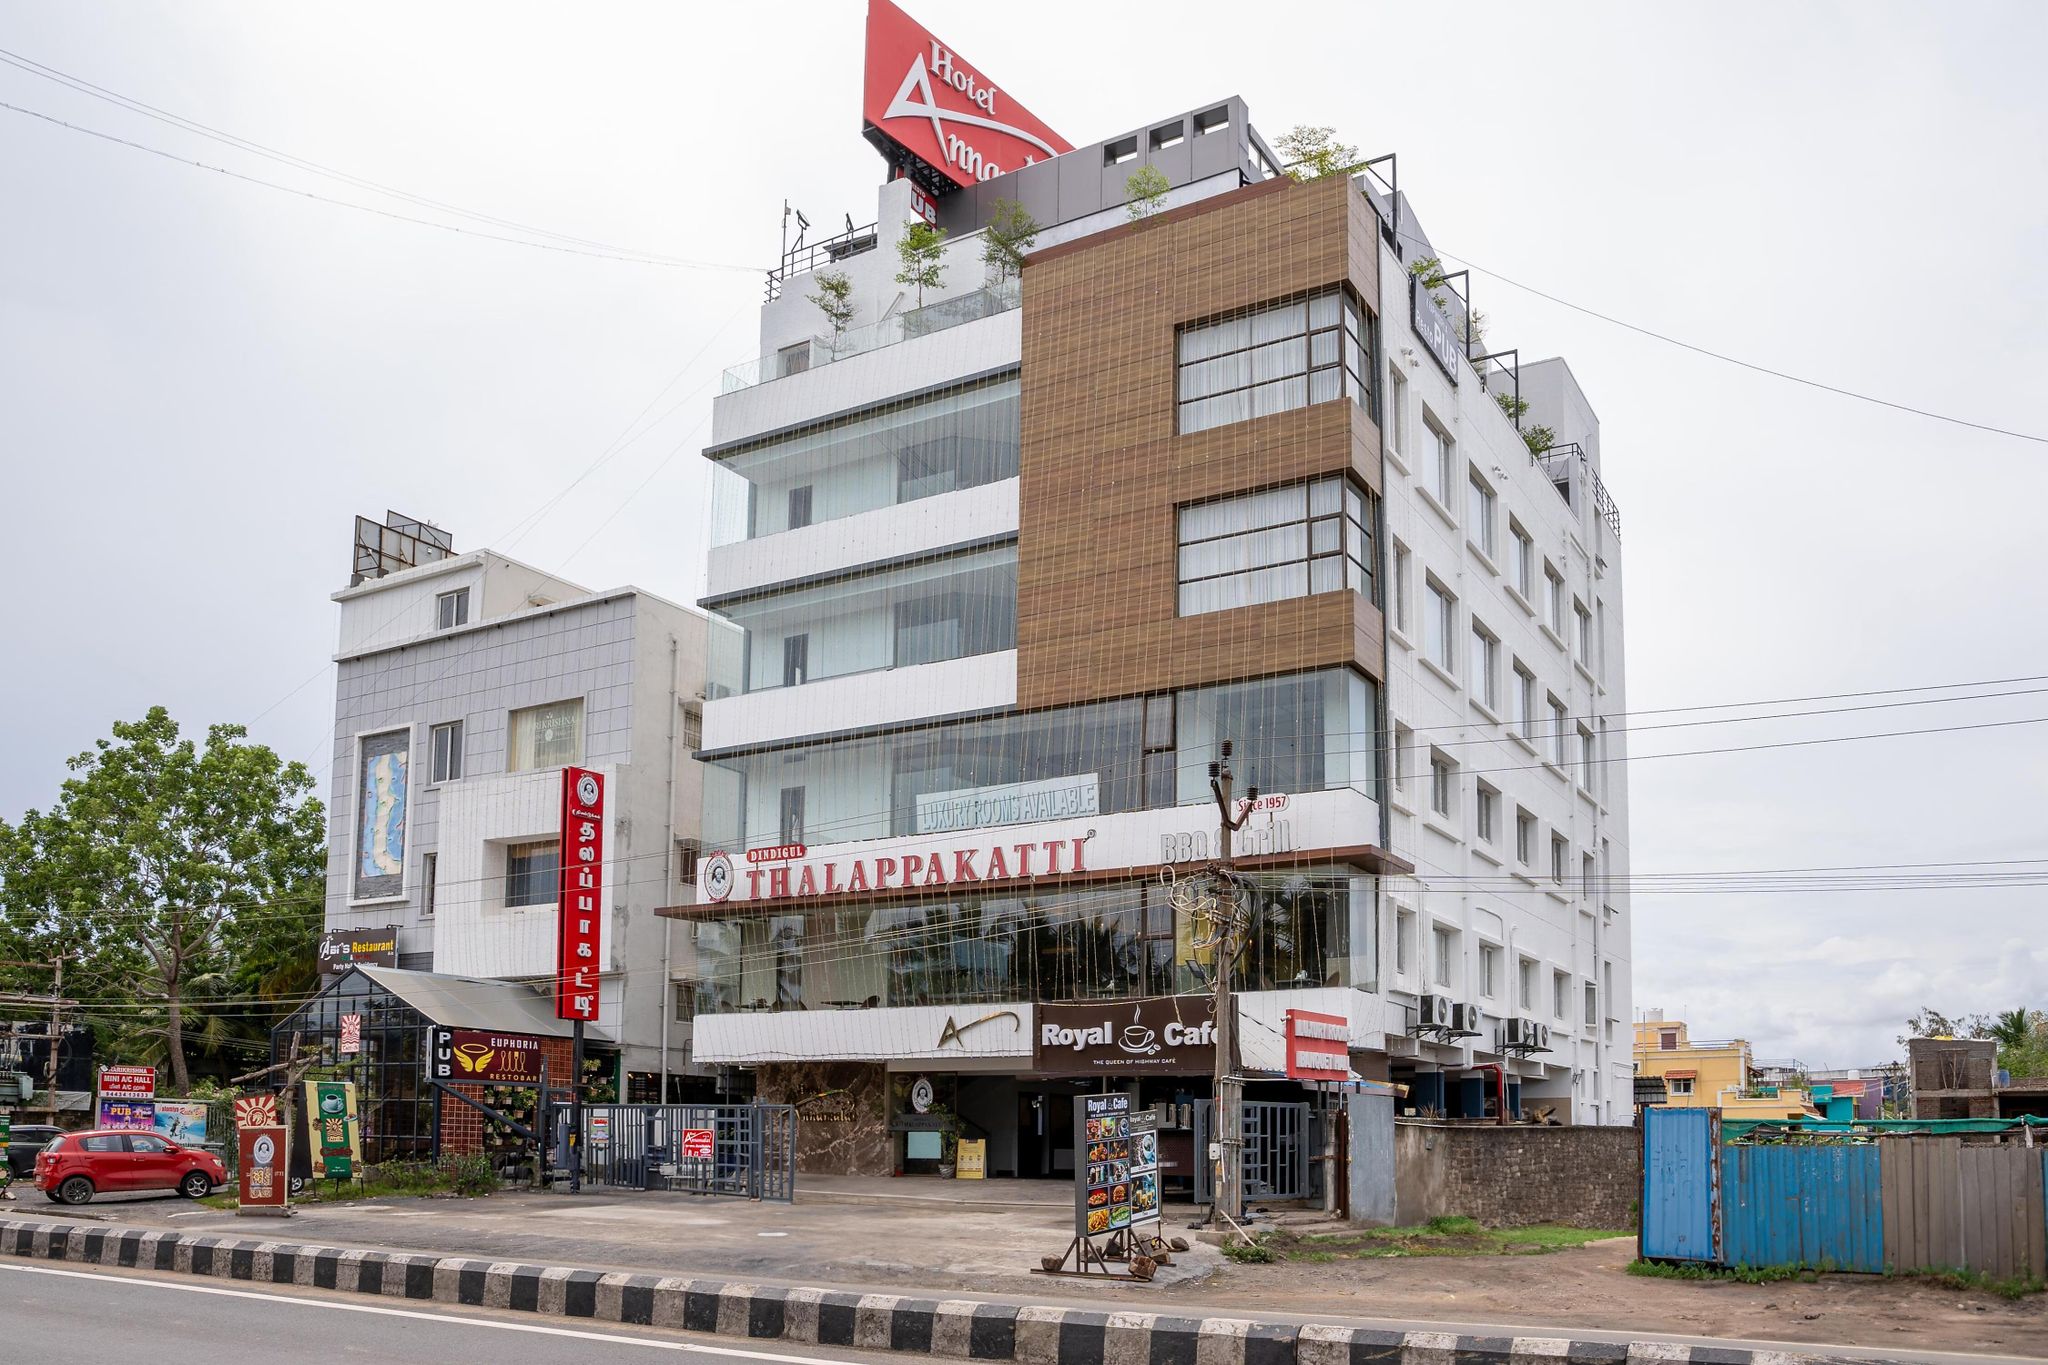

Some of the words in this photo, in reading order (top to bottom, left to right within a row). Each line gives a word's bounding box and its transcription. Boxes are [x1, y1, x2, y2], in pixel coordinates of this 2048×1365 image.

[929, 40, 996, 115] Hotel
[911, 190, 937, 224] UB
[1433, 321, 1457, 375] PUB
[923, 799, 971, 831] LUXURY
[974, 794, 1020, 825] ROOMS
[1024, 785, 1097, 820] AVAILABLE
[1264, 796, 1286, 809] 1957
[750, 846, 803, 861] DINDIGUL
[746, 838, 1088, 900] THALAPPAKATTI
[352, 940, 394, 953] Restaurant
[490, 1037, 538, 1050] EUPHORIA
[1042, 1021, 1113, 1051] Royal
[438, 1031, 451, 1077] PUB
[107, 1066, 147, 1074] ARIKRISHNA
[489, 1073, 538, 1082] RESTOBAR
[111, 1107, 131, 1116] PUB
[1087, 1098, 1107, 1113] Royal
[1113, 1097, 1128, 1109] Cafe
